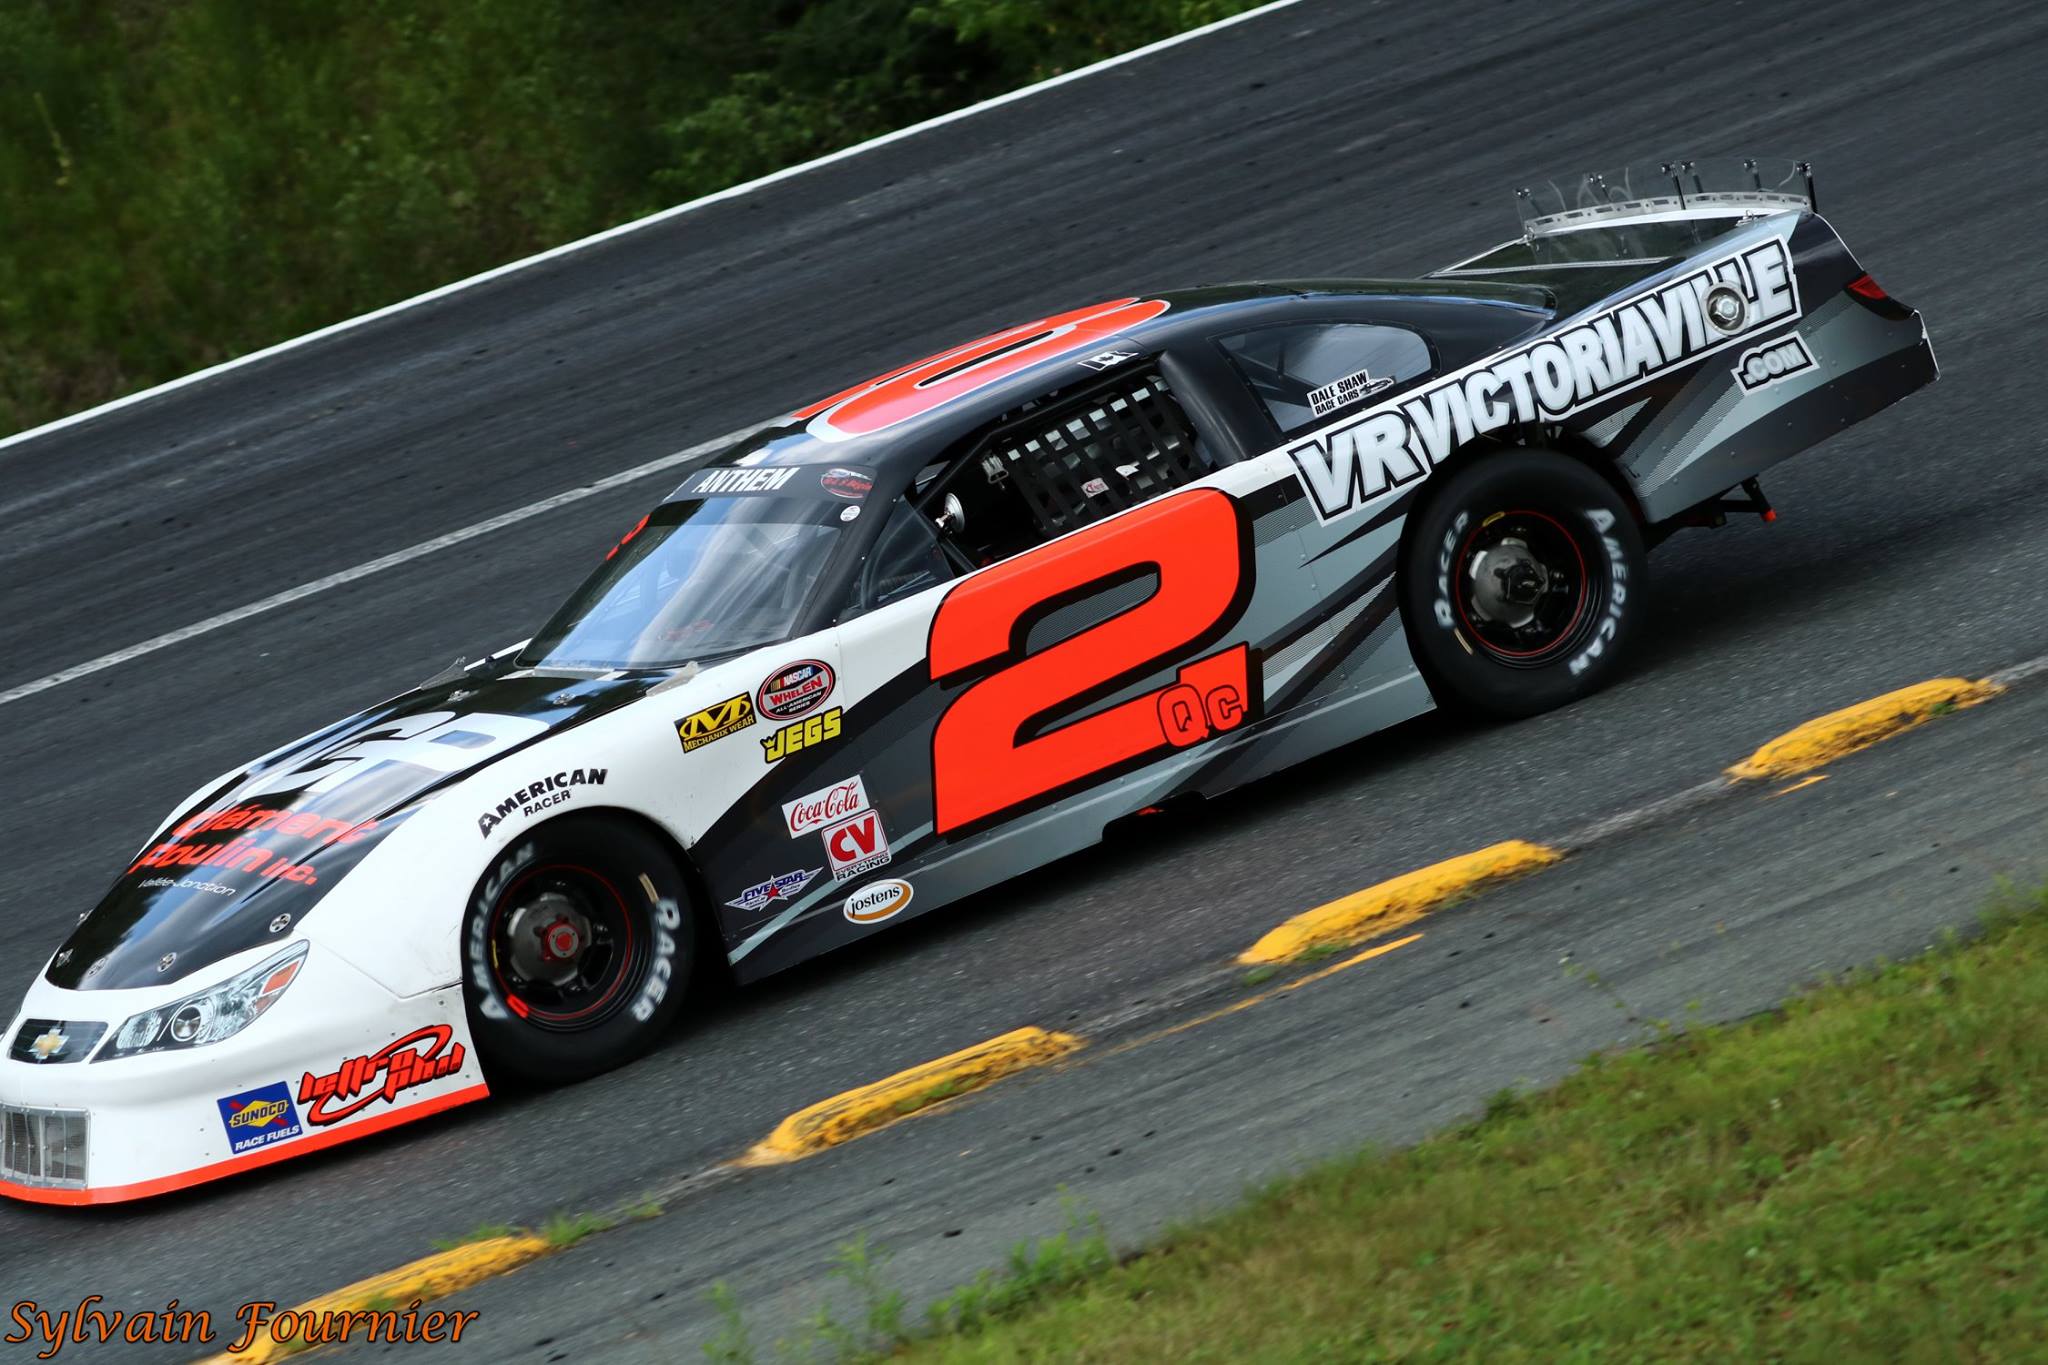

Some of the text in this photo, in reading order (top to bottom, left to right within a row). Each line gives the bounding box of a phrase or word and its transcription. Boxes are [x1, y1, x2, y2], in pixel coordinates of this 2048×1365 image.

[1743, 341, 1807, 386] .COM
[1310, 371, 1368, 405] DALE SHAW
[1315, 389, 1360, 415] RACE CARS
[691, 467, 800, 493] ANTHEM
[1433, 510, 1470, 629] RACER
[1568, 509, 1628, 676] AMERICAN
[783, 666, 813, 686] NASCAR
[928, 487, 1246, 836] 2
[769, 675, 822, 706] WHELEN
[788, 701, 811, 713] SERIES
[684, 715, 755, 751] MECHANIX WEAR
[765, 707, 842, 763] JEGS
[477, 768, 609, 839] AMERICAN
[523, 789, 571, 816] RACER
[789, 782, 859, 832] Coca-Cola
[127, 837, 274, 874] poulin
[829, 816, 876, 862] CV
[744, 872, 805, 900] FIVE STAR
[836, 857, 890, 881] RACING
[850, 884, 900, 918] jostens
[469, 842, 535, 1020] AMERICAN
[631, 899, 681, 1022] RACER
[232, 1100, 287, 1127] SUNOCO
[235, 1125, 299, 1151] RACE FUELS
